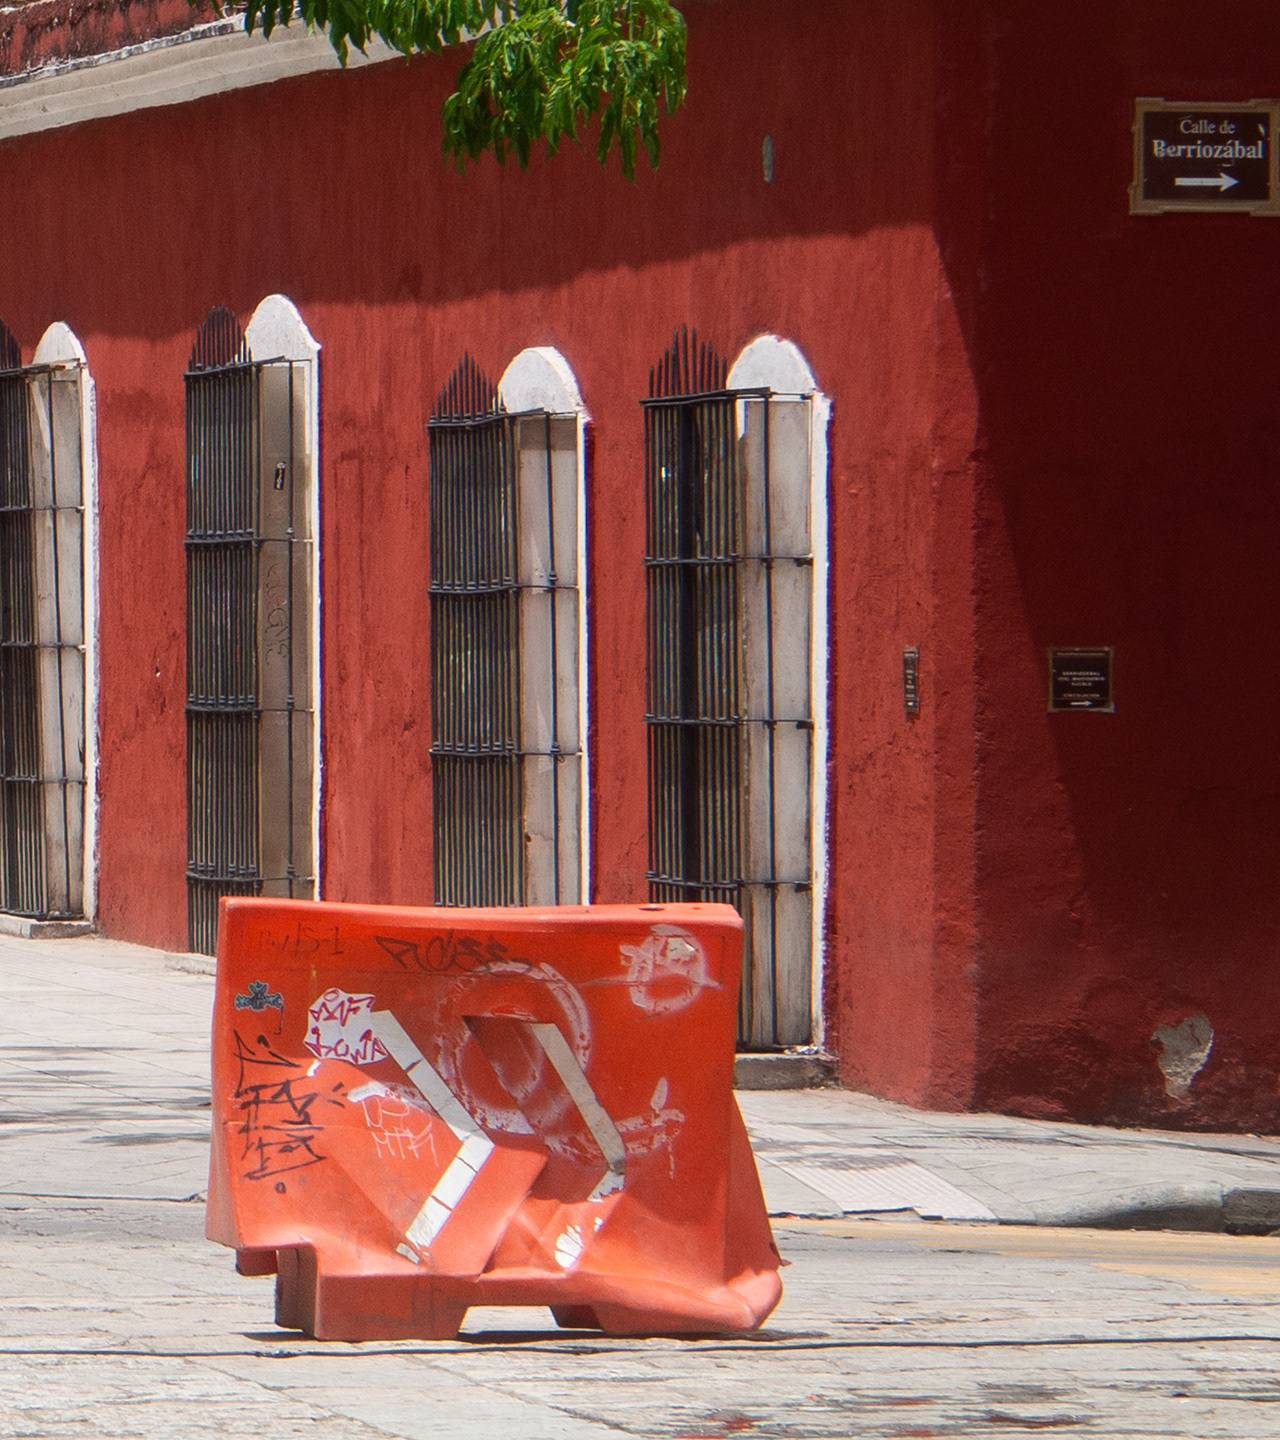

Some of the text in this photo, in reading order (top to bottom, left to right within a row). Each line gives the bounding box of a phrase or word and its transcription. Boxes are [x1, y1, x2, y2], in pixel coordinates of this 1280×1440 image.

[1180, 120, 1236, 134] Calle de
[1152, 139, 1265, 159] Berriozábal
